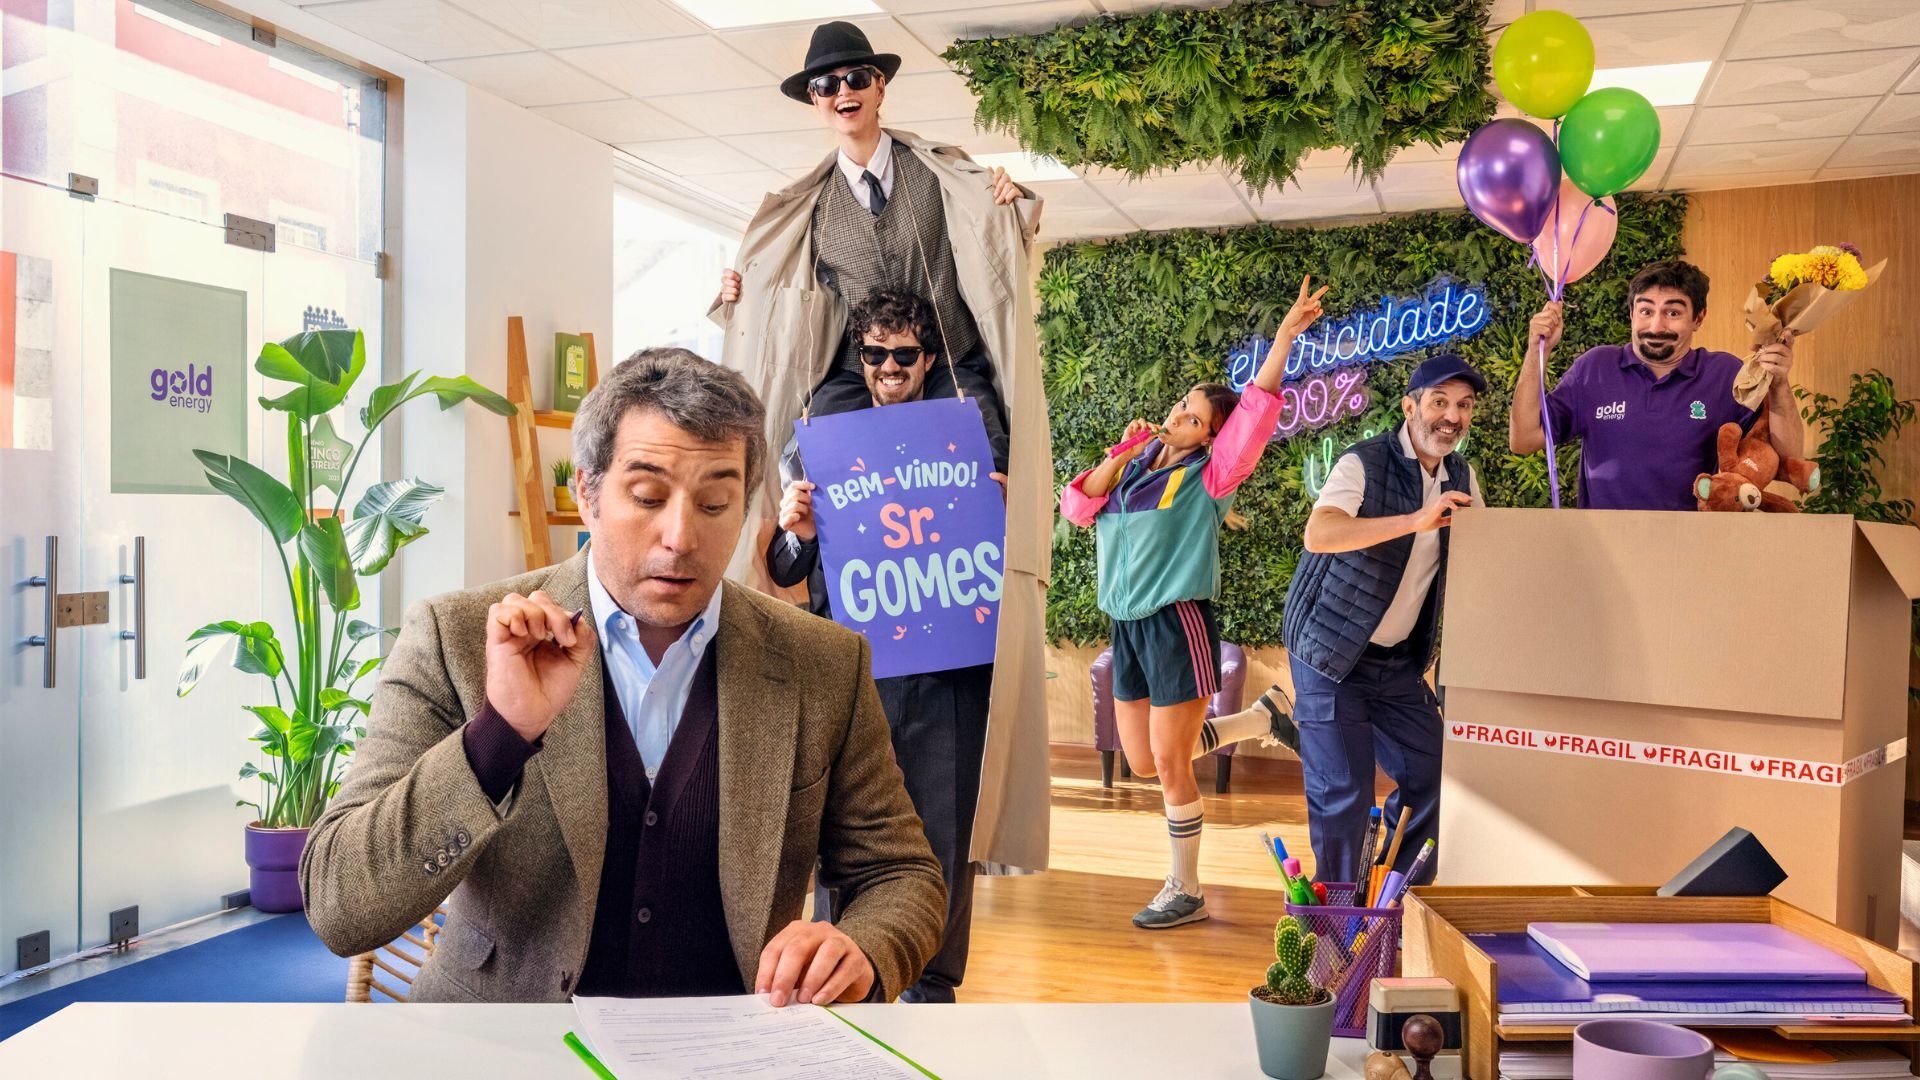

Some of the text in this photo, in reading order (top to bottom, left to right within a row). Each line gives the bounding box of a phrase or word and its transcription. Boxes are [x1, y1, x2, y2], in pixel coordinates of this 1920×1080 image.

[1231, 286, 1484, 388] elricidade
[150, 362, 212, 401] gold
[169, 395, 212, 414] energy
[1273, 373, 1362, 435] 00%
[1595, 400, 1626, 419] gold
[1602, 412, 1626, 421] energy
[307, 460, 341, 470] STRELAS
[879, 502, 941, 549] Sr.
[1466, 725, 1842, 784] FRAGIL FRAGIL FRAGIL FRAGI
